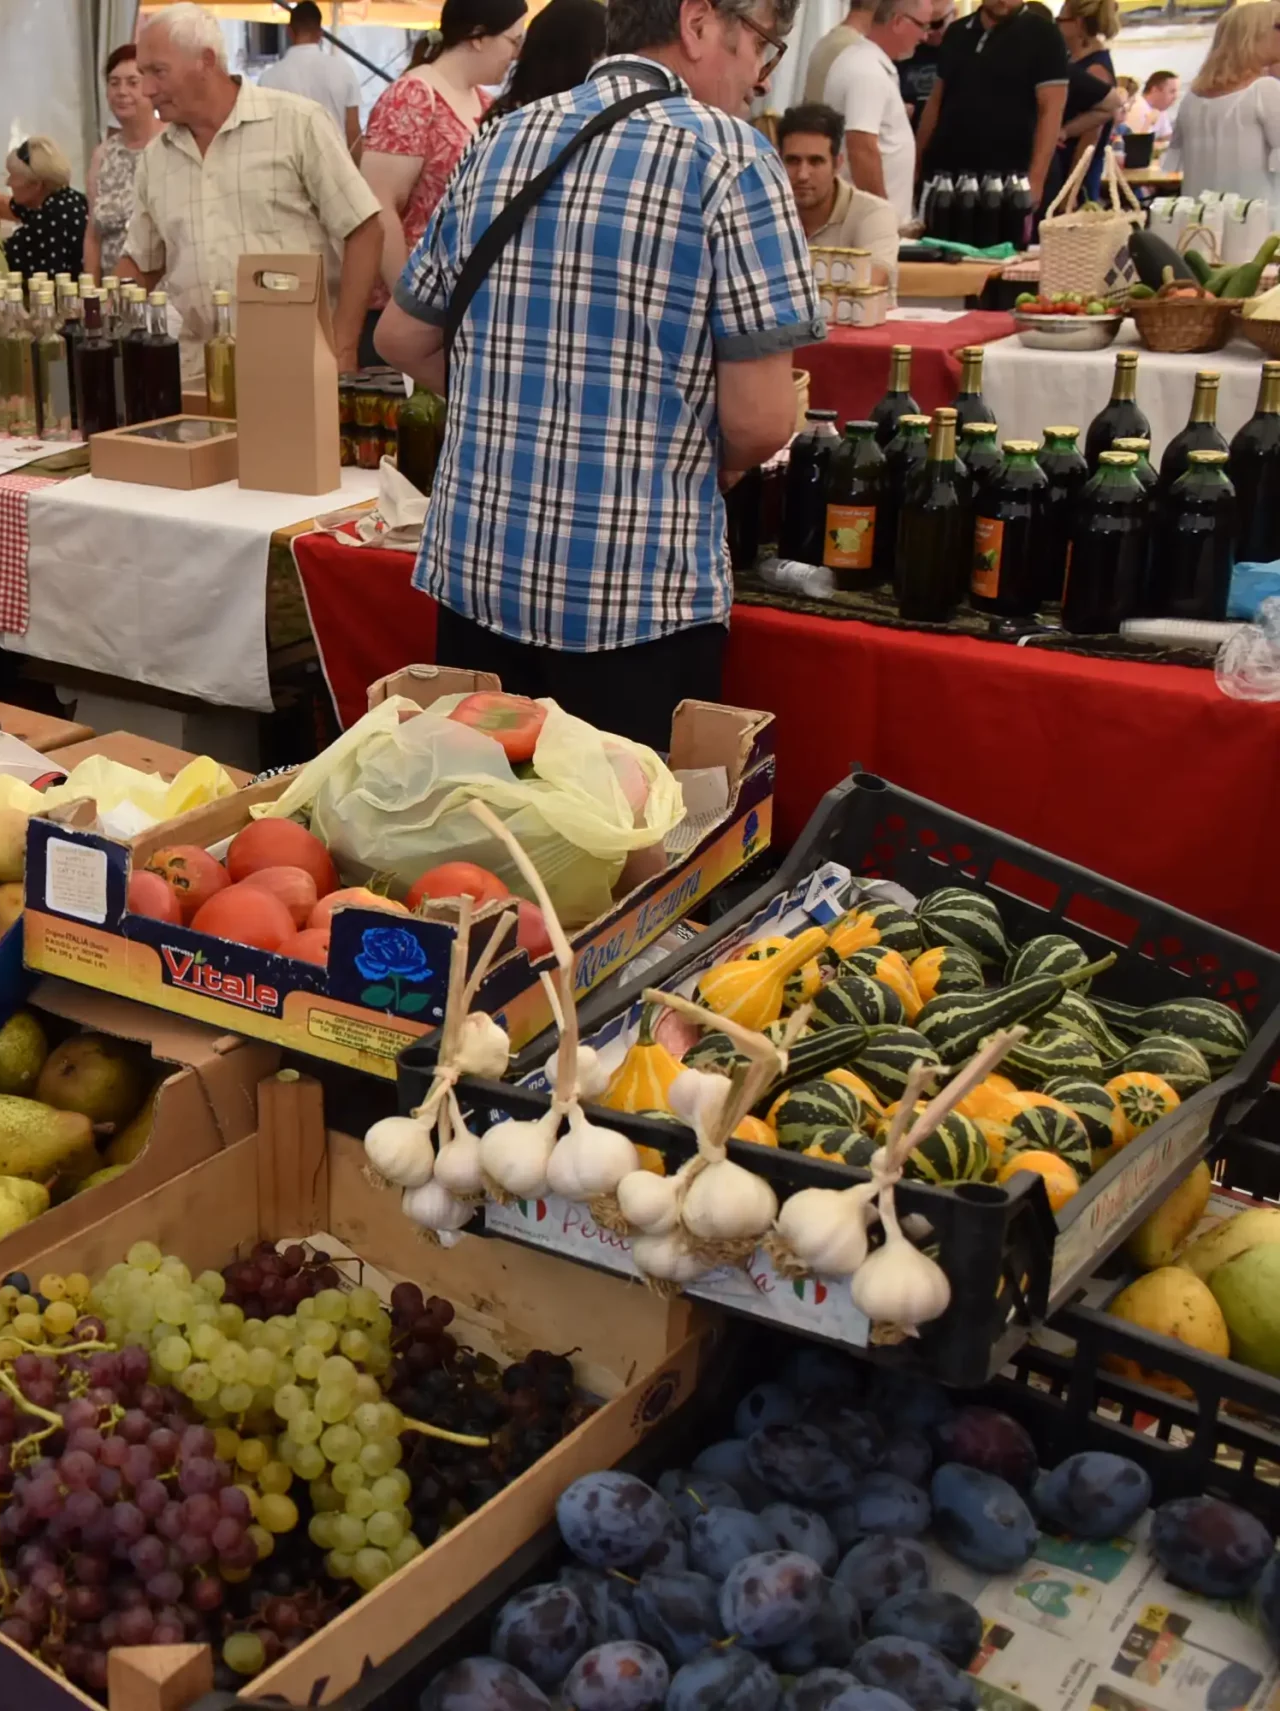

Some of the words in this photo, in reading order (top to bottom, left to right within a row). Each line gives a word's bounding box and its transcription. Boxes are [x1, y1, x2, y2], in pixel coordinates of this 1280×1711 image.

[65, 932, 88, 946] ITALIA
[575, 928, 626, 990] Rosa
[624, 867, 702, 957] Azzurra
[161, 947, 278, 1008] Vitale
